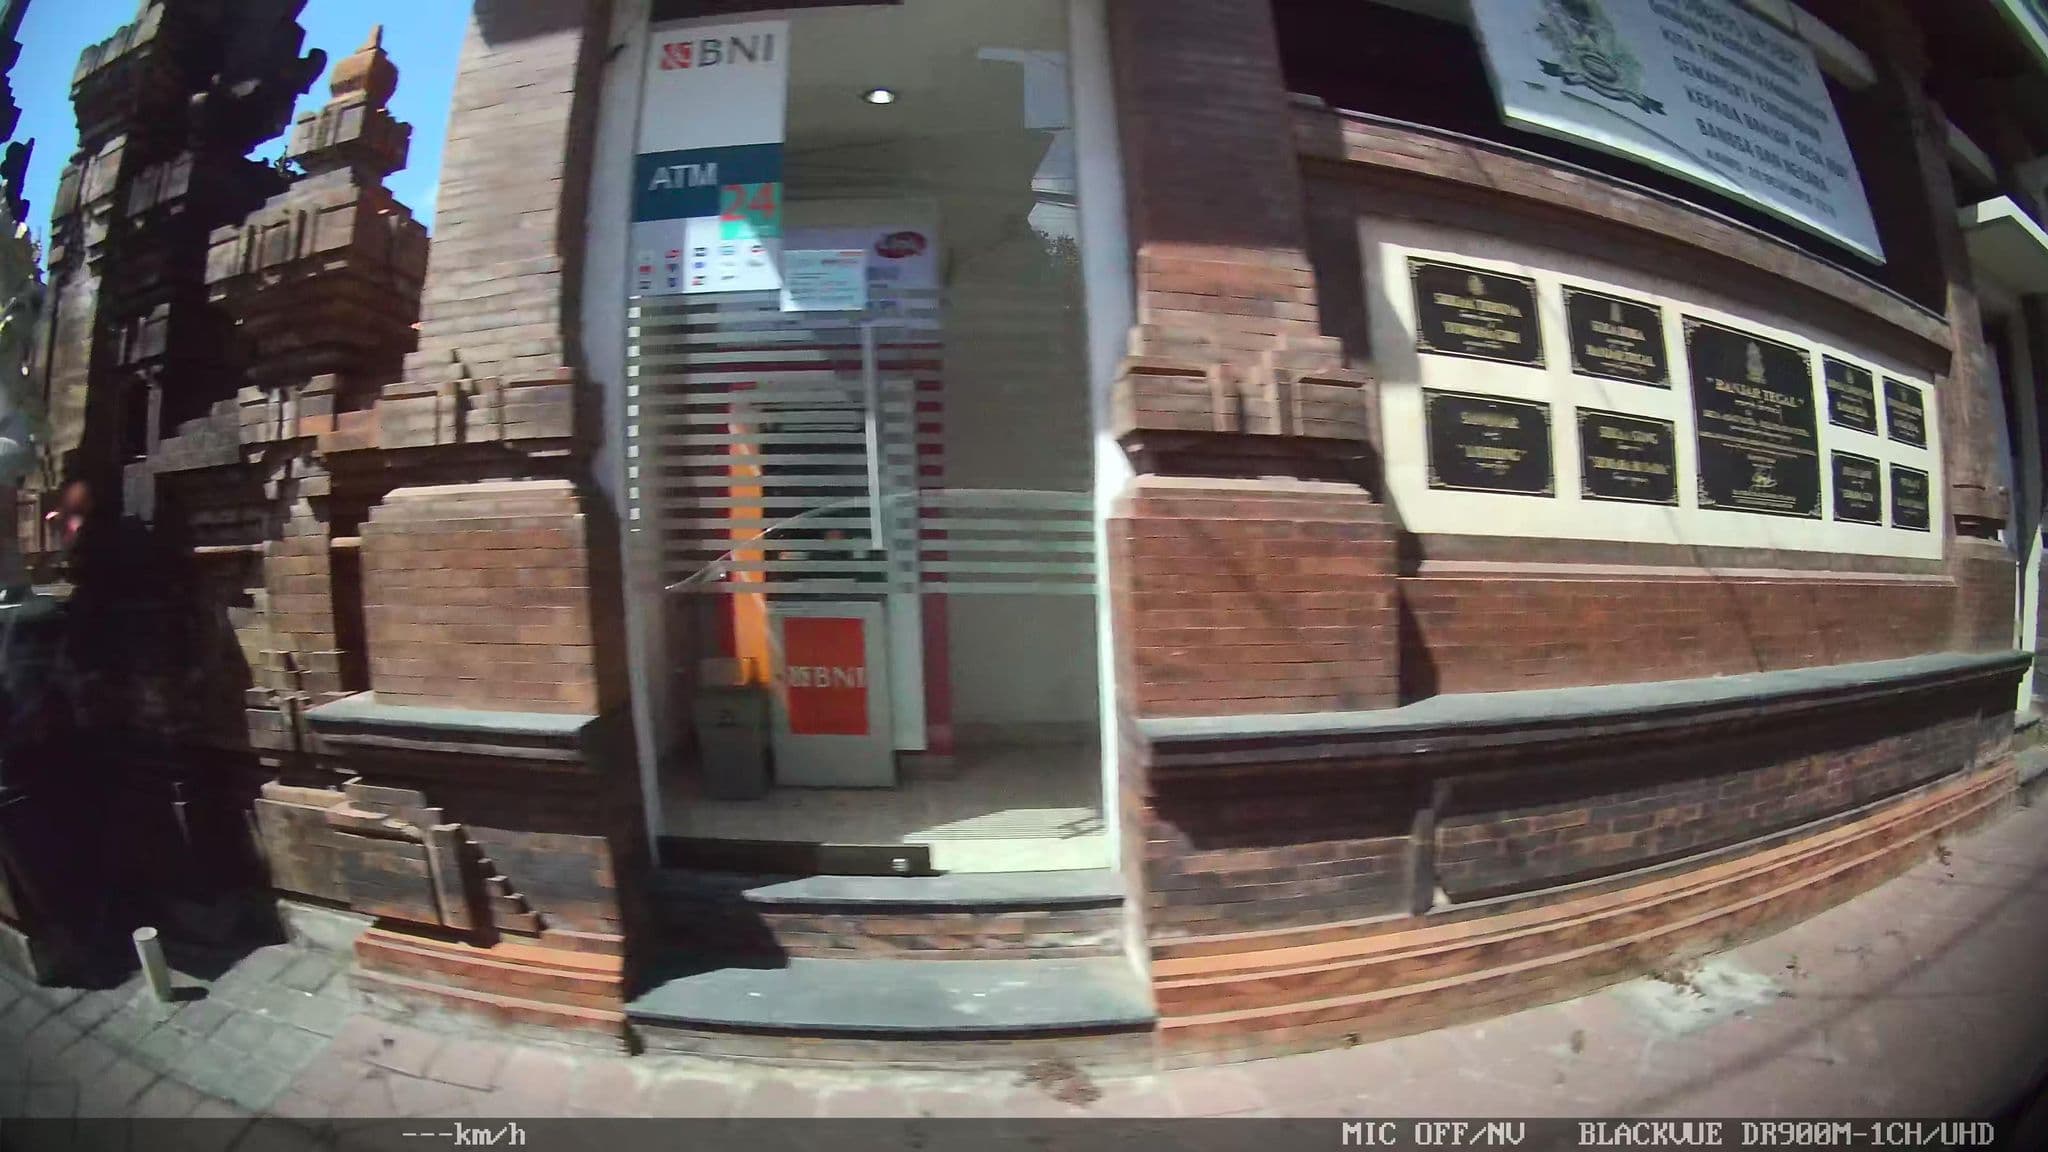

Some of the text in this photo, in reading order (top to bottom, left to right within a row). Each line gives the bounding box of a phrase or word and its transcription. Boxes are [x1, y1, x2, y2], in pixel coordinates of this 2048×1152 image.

[698, 34, 775, 67] BNI
[648, 162, 718, 191] ATM
[721, 183, 777, 222] 24
[815, 666, 865, 689] BNI
